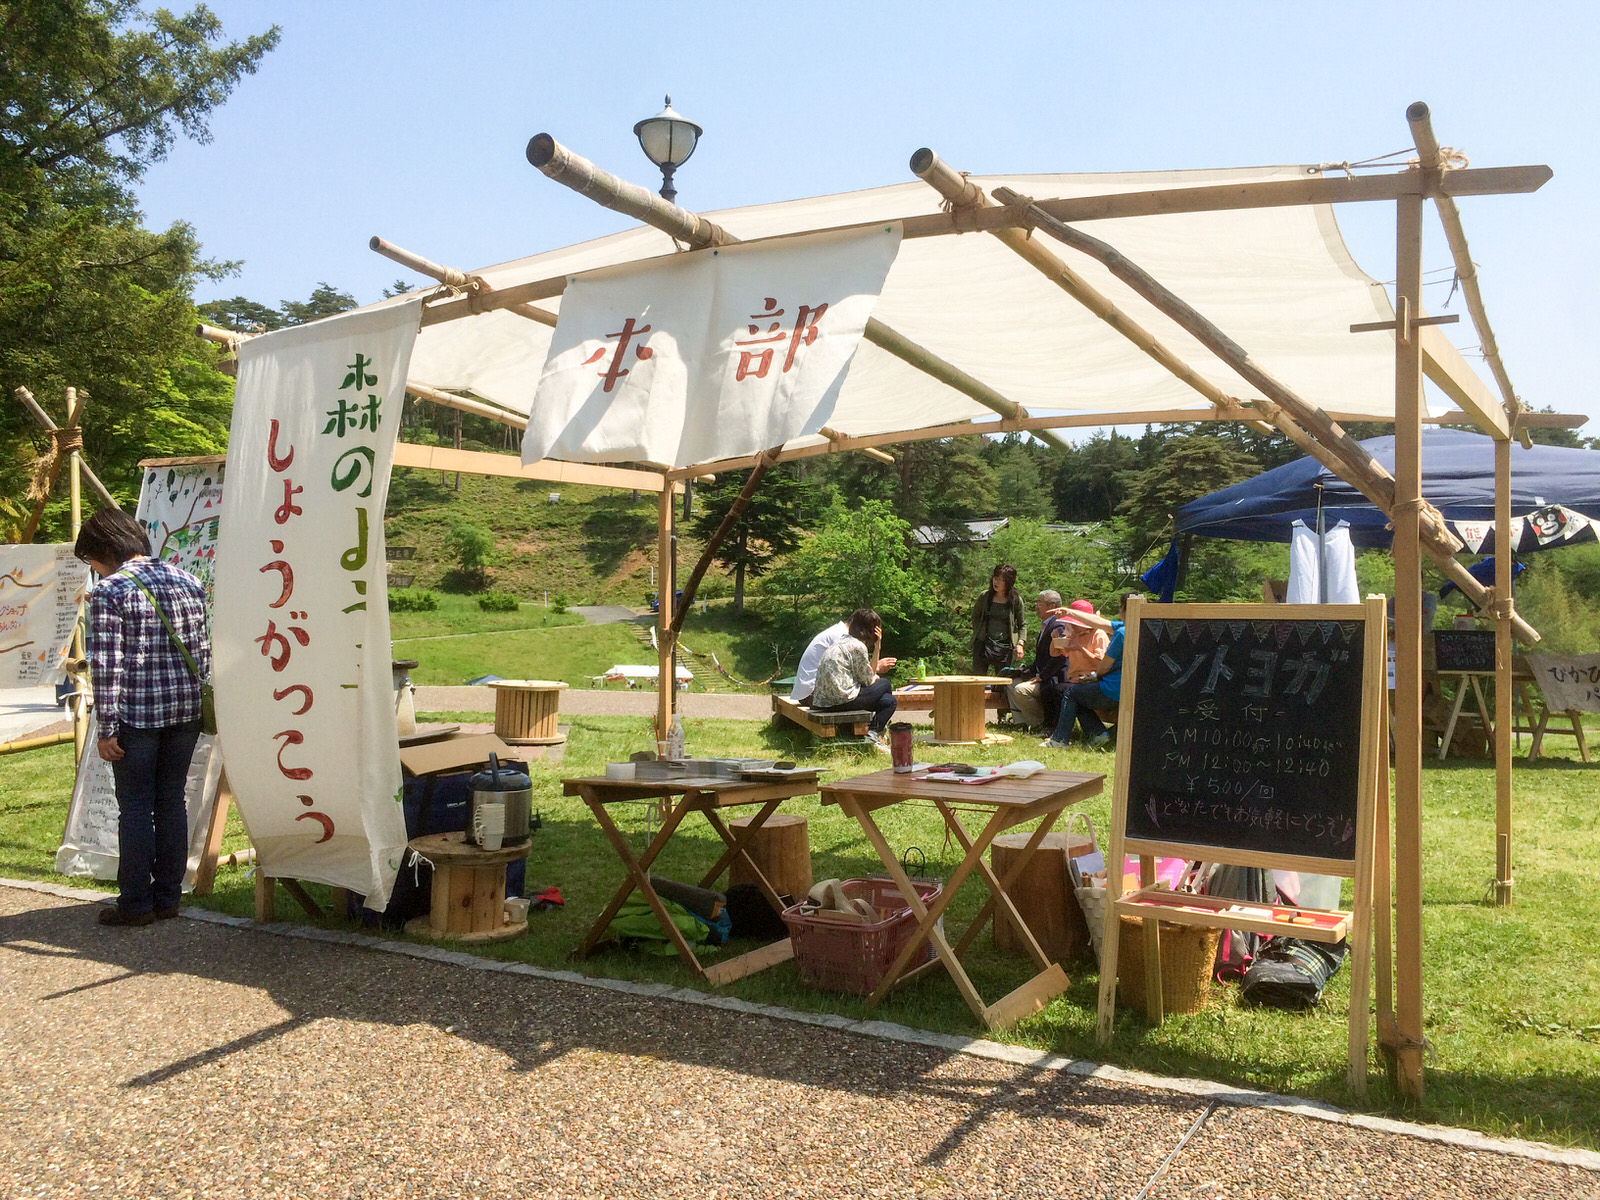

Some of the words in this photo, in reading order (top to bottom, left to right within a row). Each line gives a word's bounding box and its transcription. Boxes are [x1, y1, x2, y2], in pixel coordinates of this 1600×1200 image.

[581, 297, 829, 392] 本部
[254, 418, 335, 844] しょうがっこう
[1160, 645, 1350, 704] ソトヨガ
